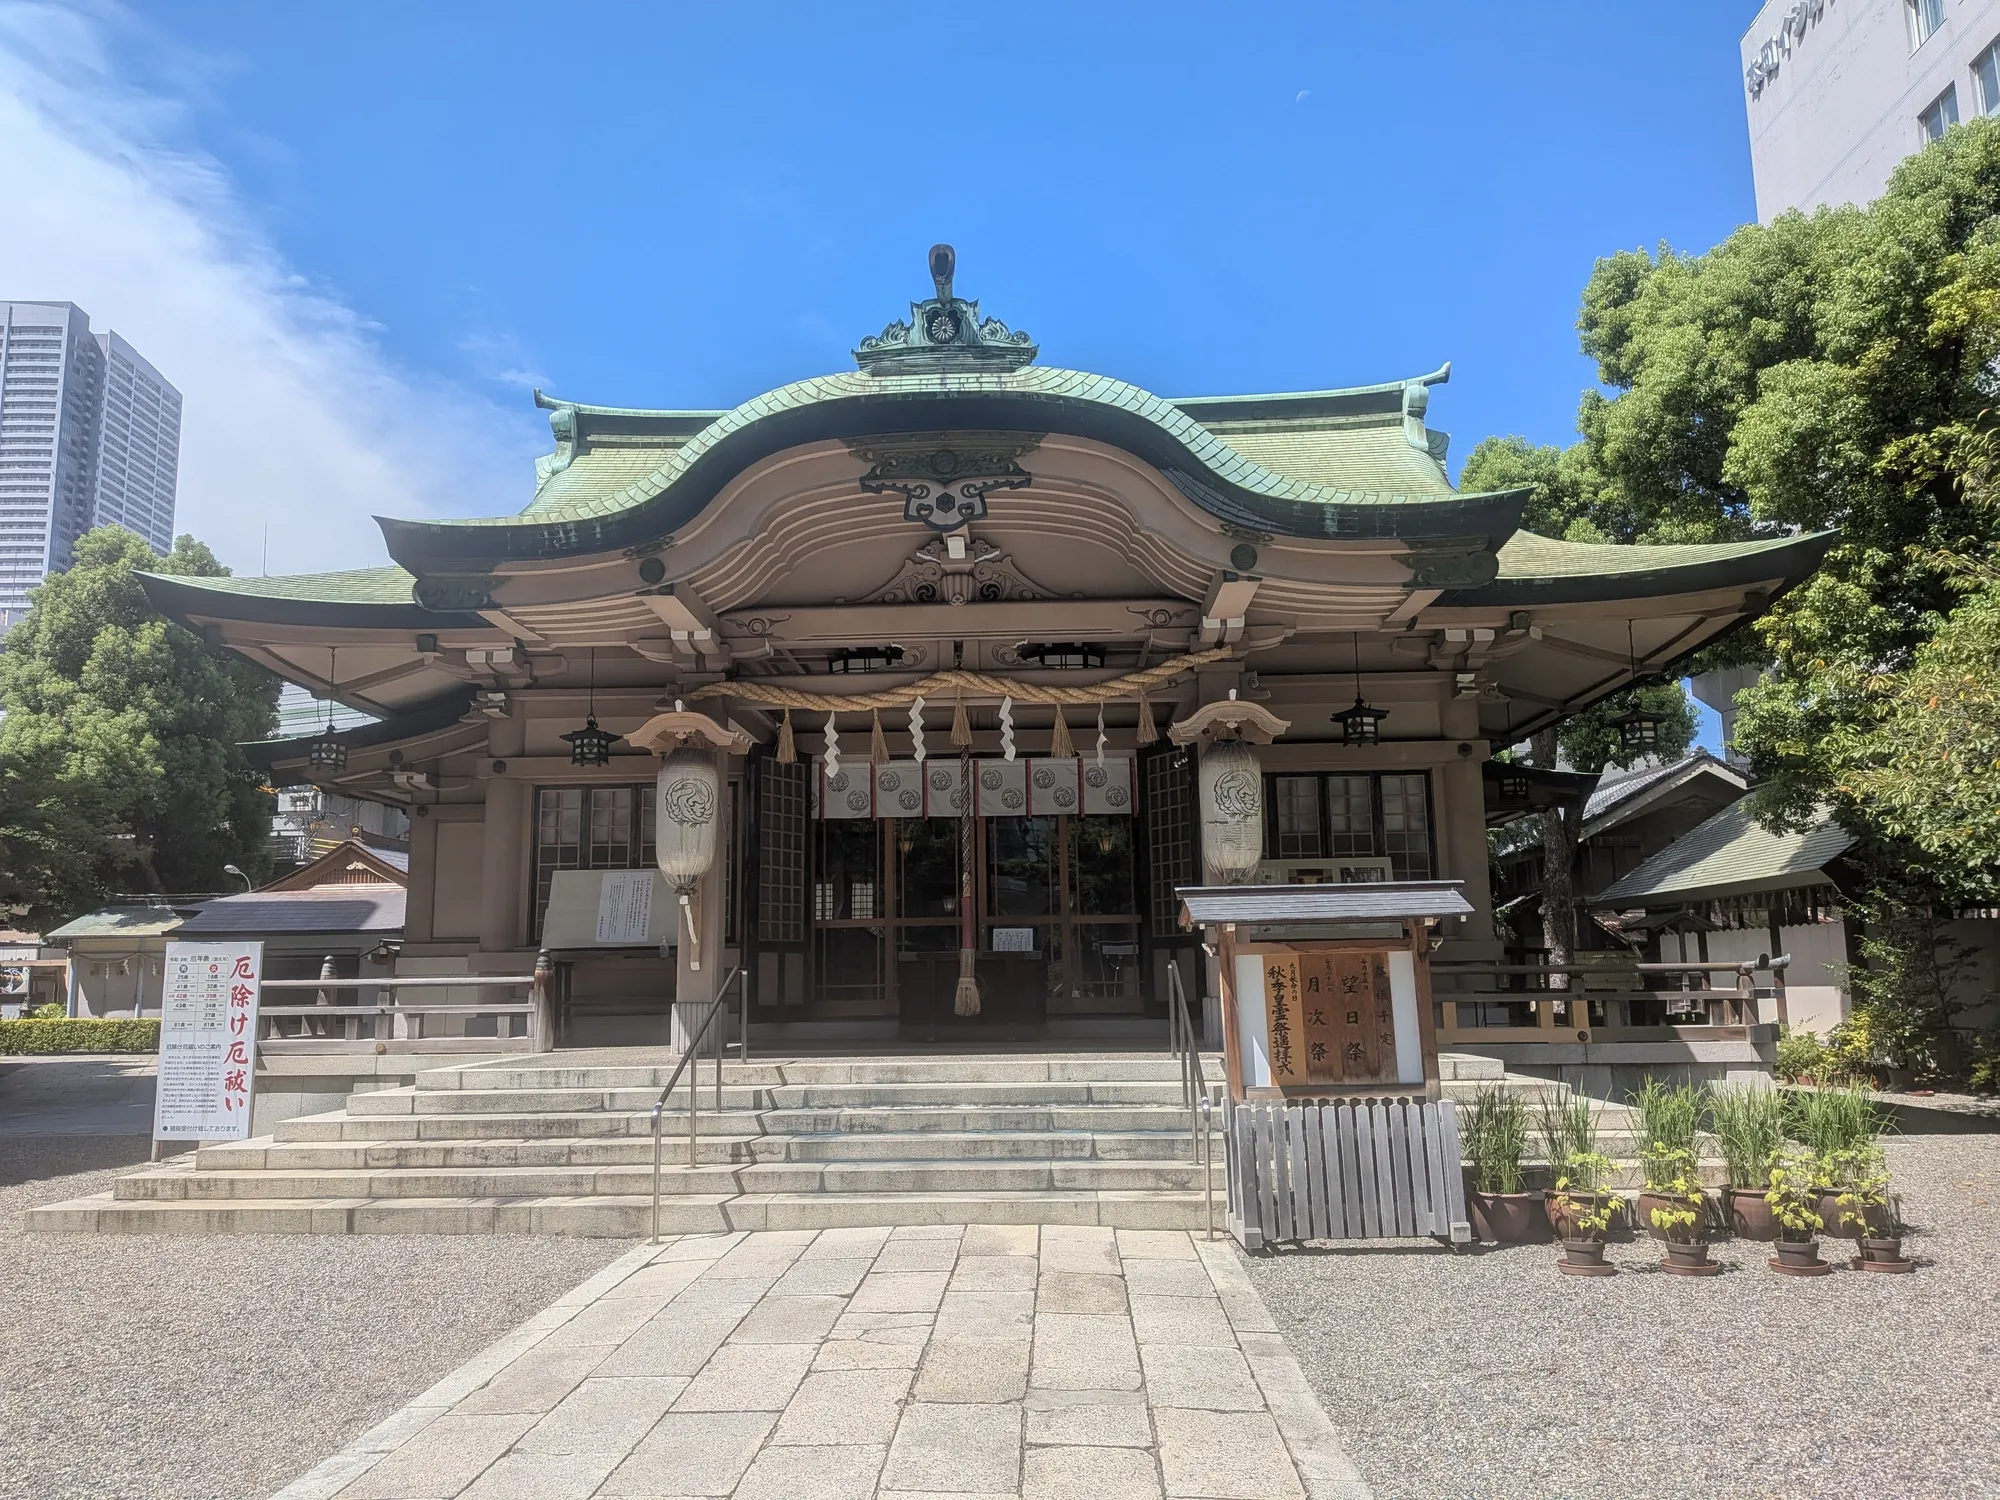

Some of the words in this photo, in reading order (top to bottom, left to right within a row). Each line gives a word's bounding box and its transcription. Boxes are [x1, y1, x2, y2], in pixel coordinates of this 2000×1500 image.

[1289, 962, 1299, 1002] 九月秋分の日
[1307, 976, 1329, 1062] 月次祭
[1341, 975, 1365, 1062] 望日祭
[222, 955, 255, 1112] 厄除け厄祓い
